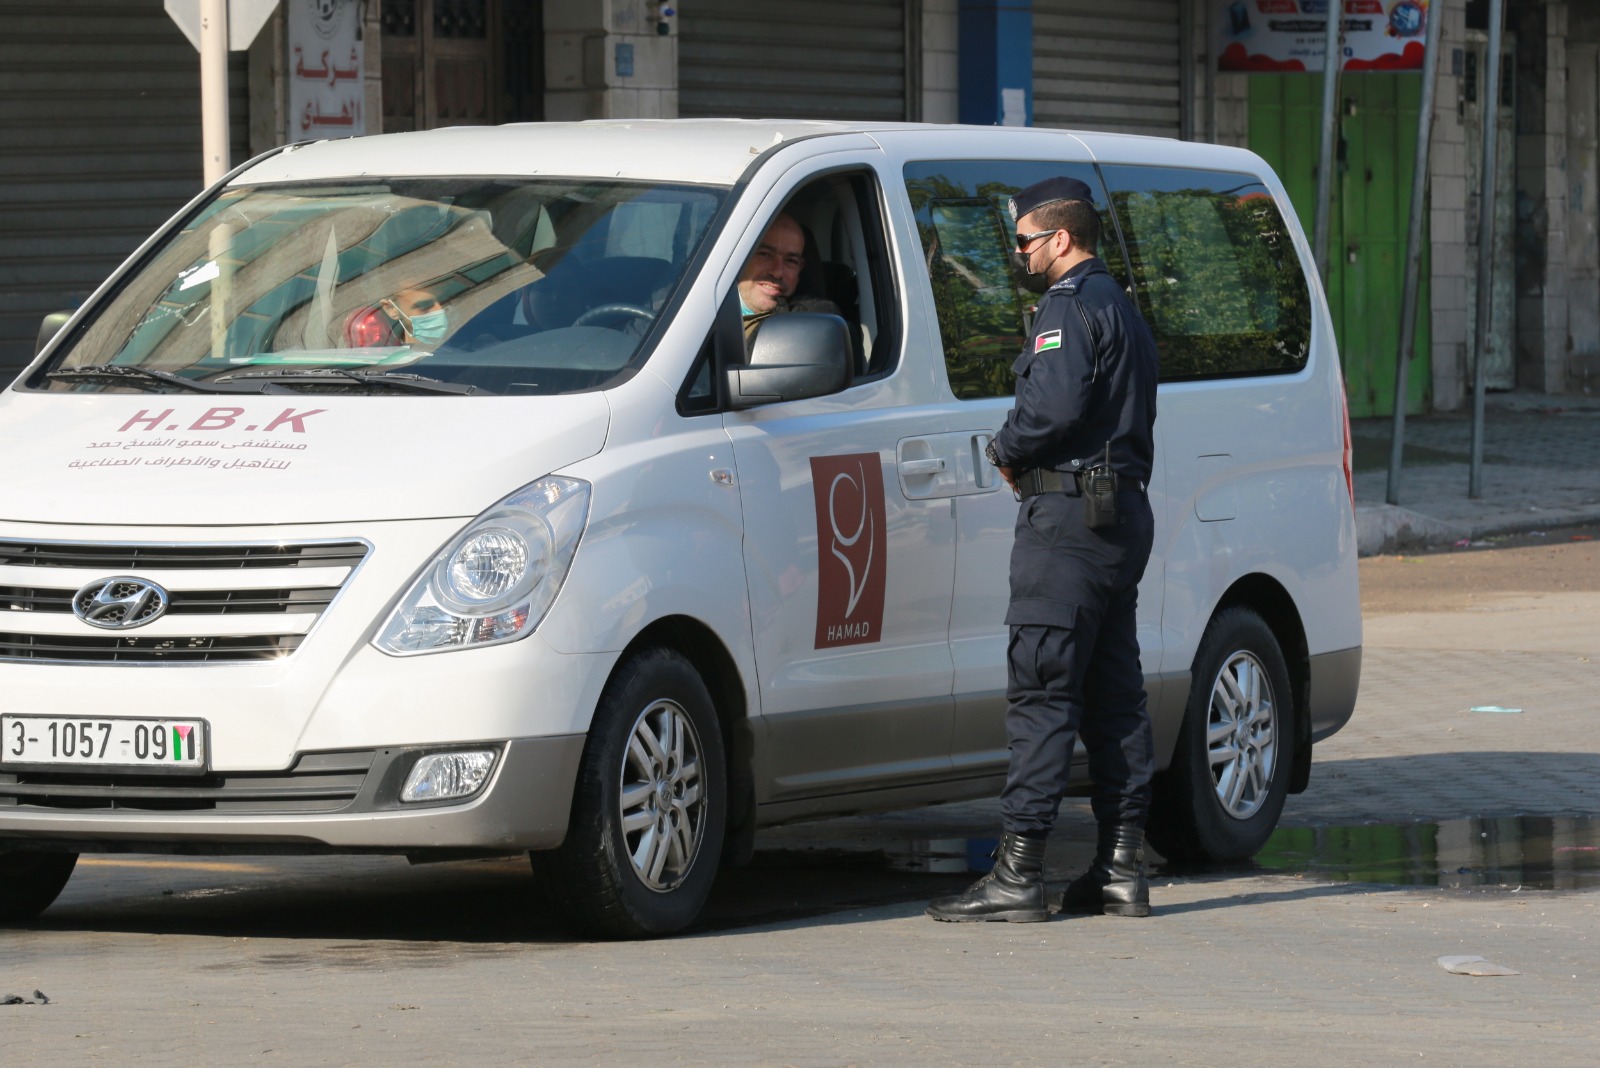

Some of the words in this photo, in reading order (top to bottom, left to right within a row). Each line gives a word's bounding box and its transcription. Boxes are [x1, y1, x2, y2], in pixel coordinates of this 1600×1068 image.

[294, 47, 359, 88] شركة
[117, 407, 329, 433] H.B.K
[85, 441, 122, 449] حمد
[122, 437, 176, 450] الشيخ
[175, 439, 220, 449] سمو
[220, 438, 308, 450] مستشفى
[68, 457, 143, 470] الصناعية
[144, 456, 221, 468] والأطراف
[222, 458, 292, 470] للتأهيل
[827, 621, 870, 642] HAMAD
